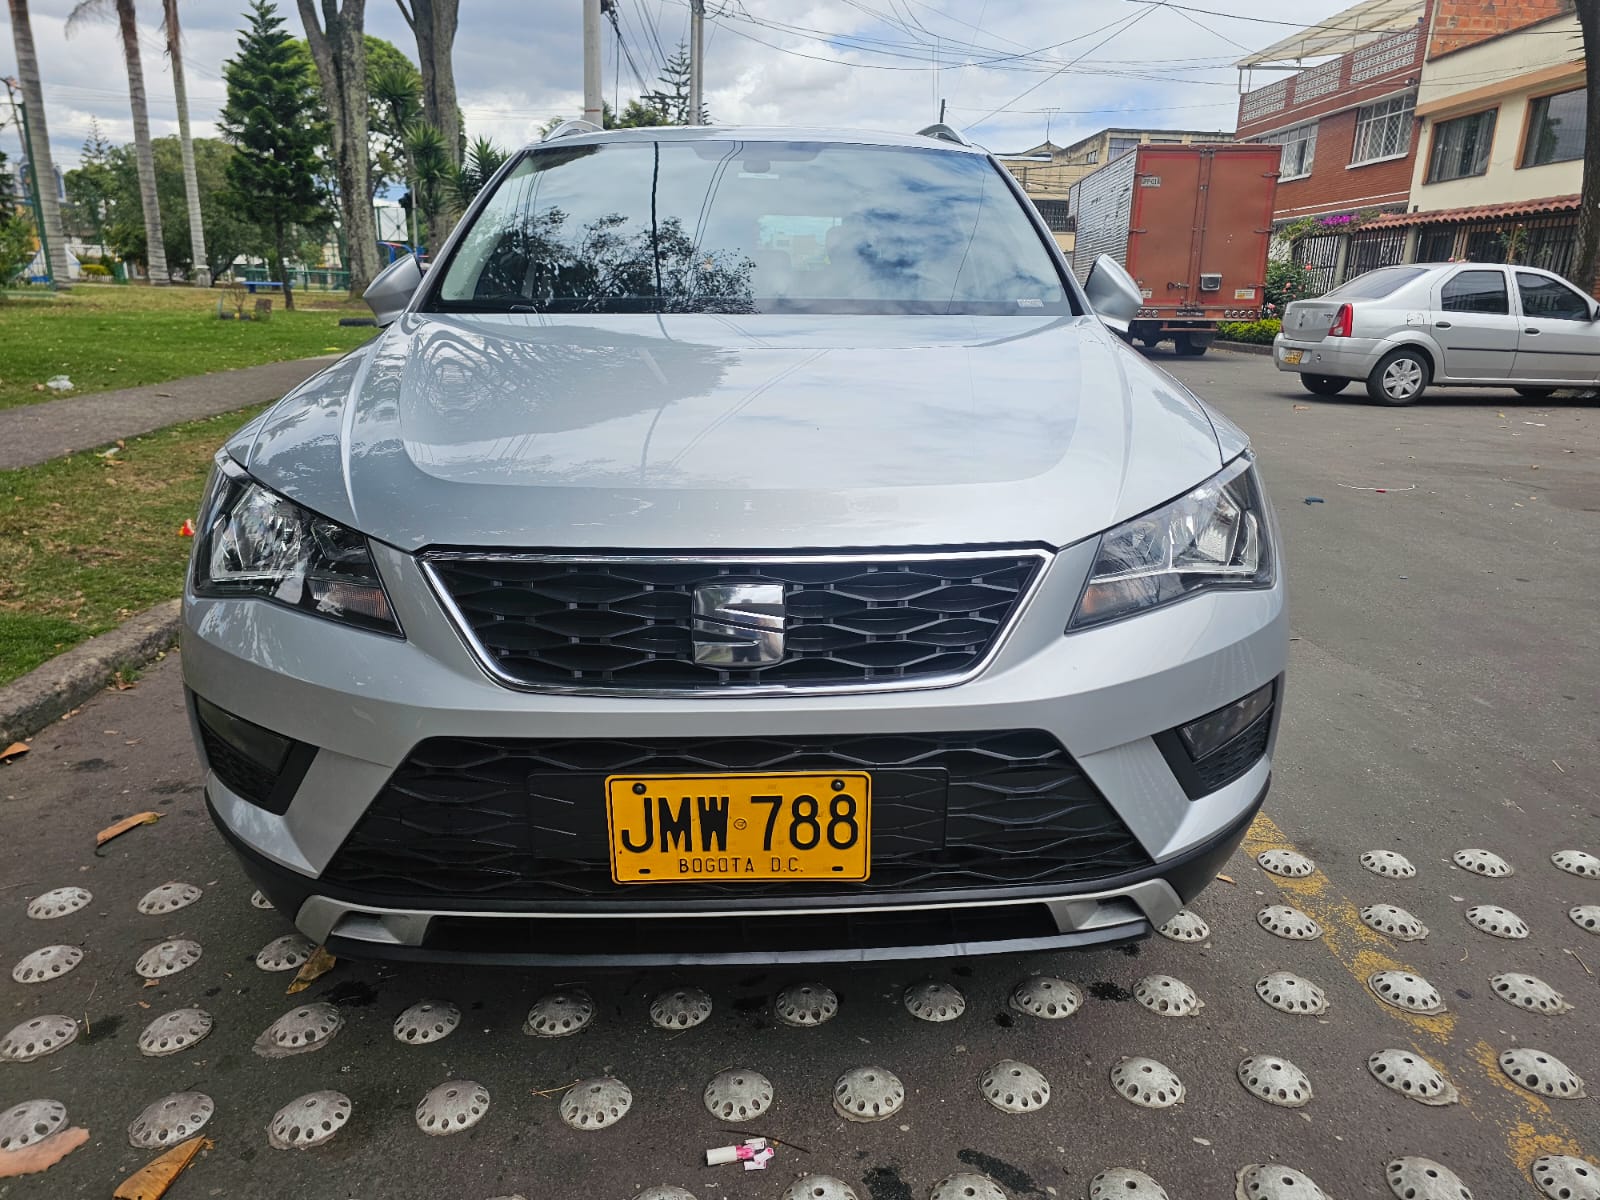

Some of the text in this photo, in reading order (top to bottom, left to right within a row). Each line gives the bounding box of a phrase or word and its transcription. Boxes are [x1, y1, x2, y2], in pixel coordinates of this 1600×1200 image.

[621, 794, 858, 853] JMW 788
[679, 857, 804, 873] BOGOTA D.C.
